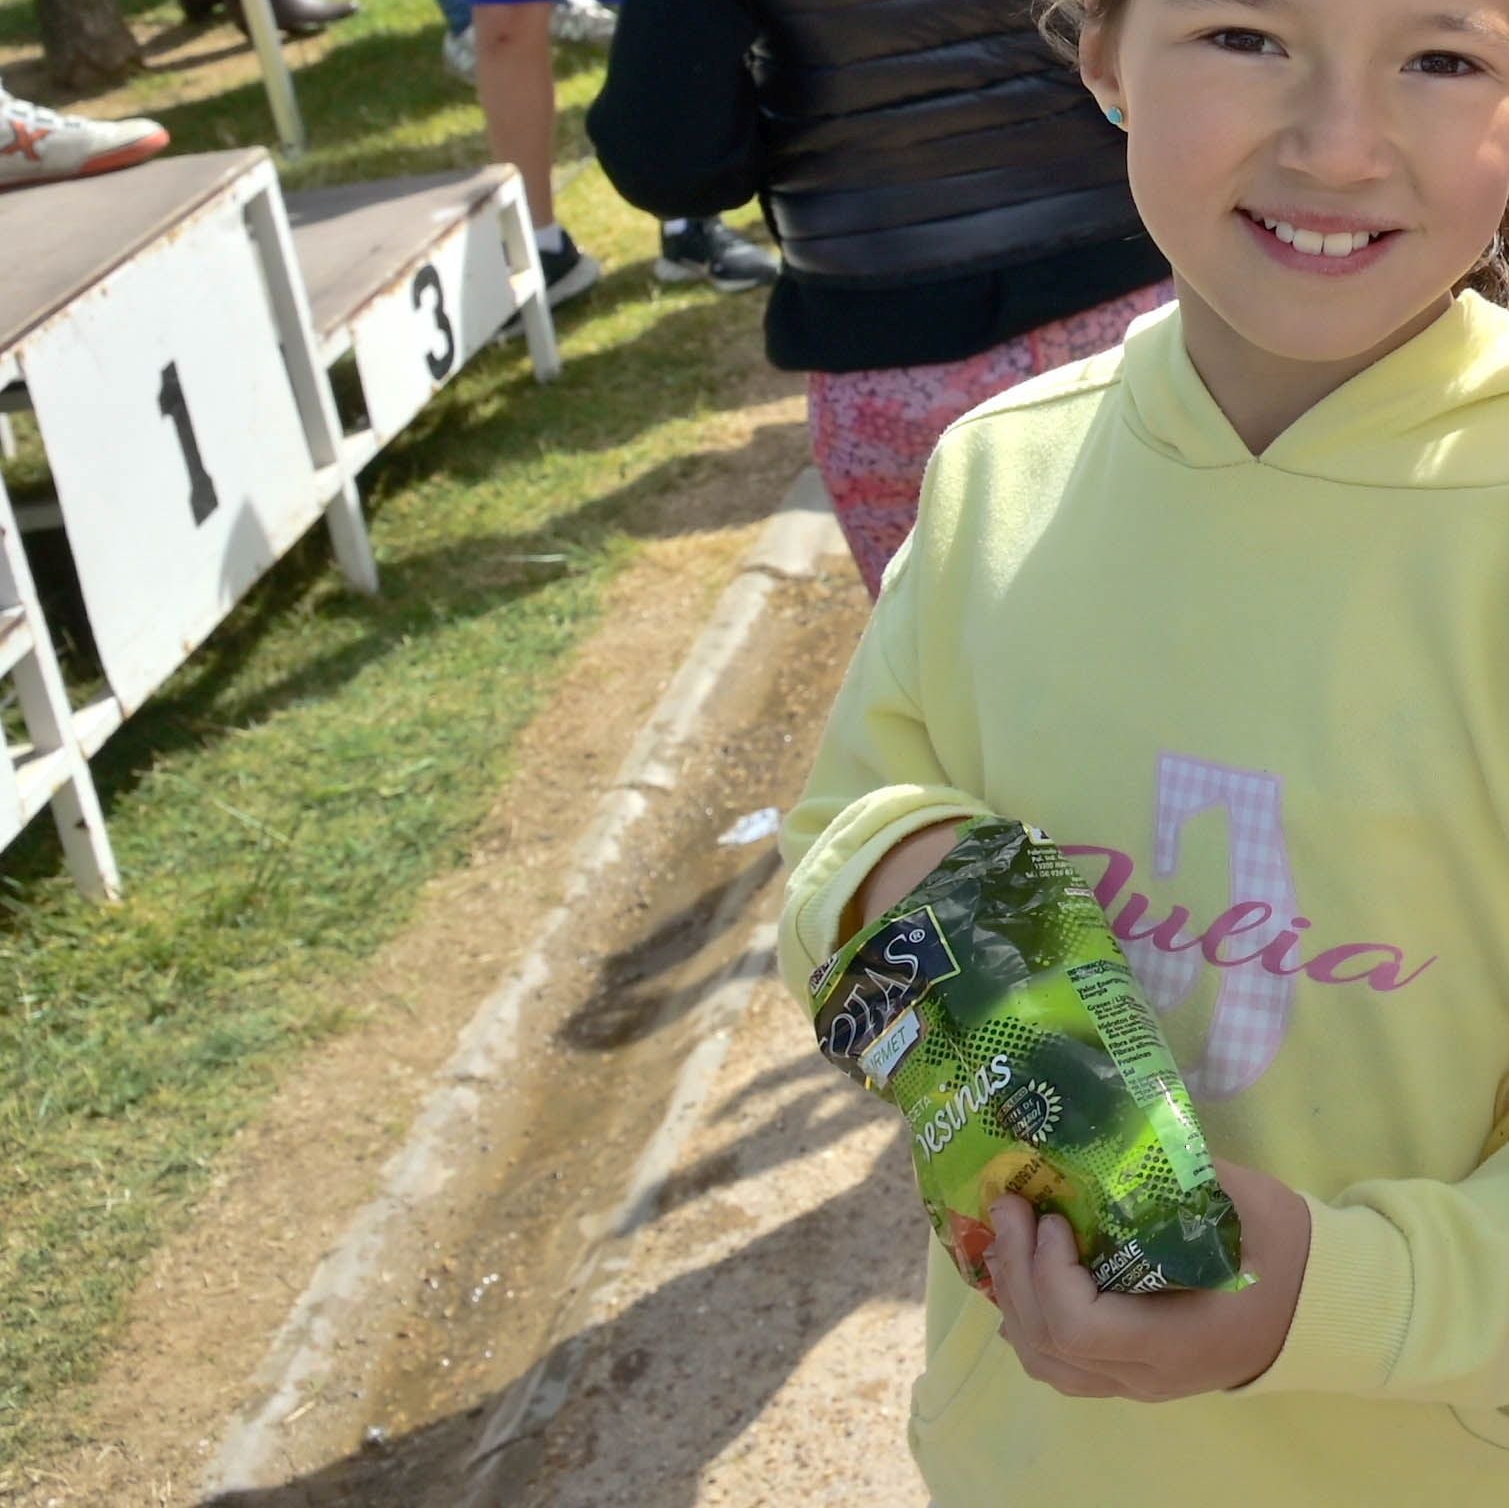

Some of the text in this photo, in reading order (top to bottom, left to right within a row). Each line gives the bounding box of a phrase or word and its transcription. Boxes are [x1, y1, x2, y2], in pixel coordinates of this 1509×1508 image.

[411, 263, 455, 381] 3
[157, 358, 219, 529] 1
[869, 1025, 907, 1071] RMET
[905, 1096, 933, 1126] CETA
